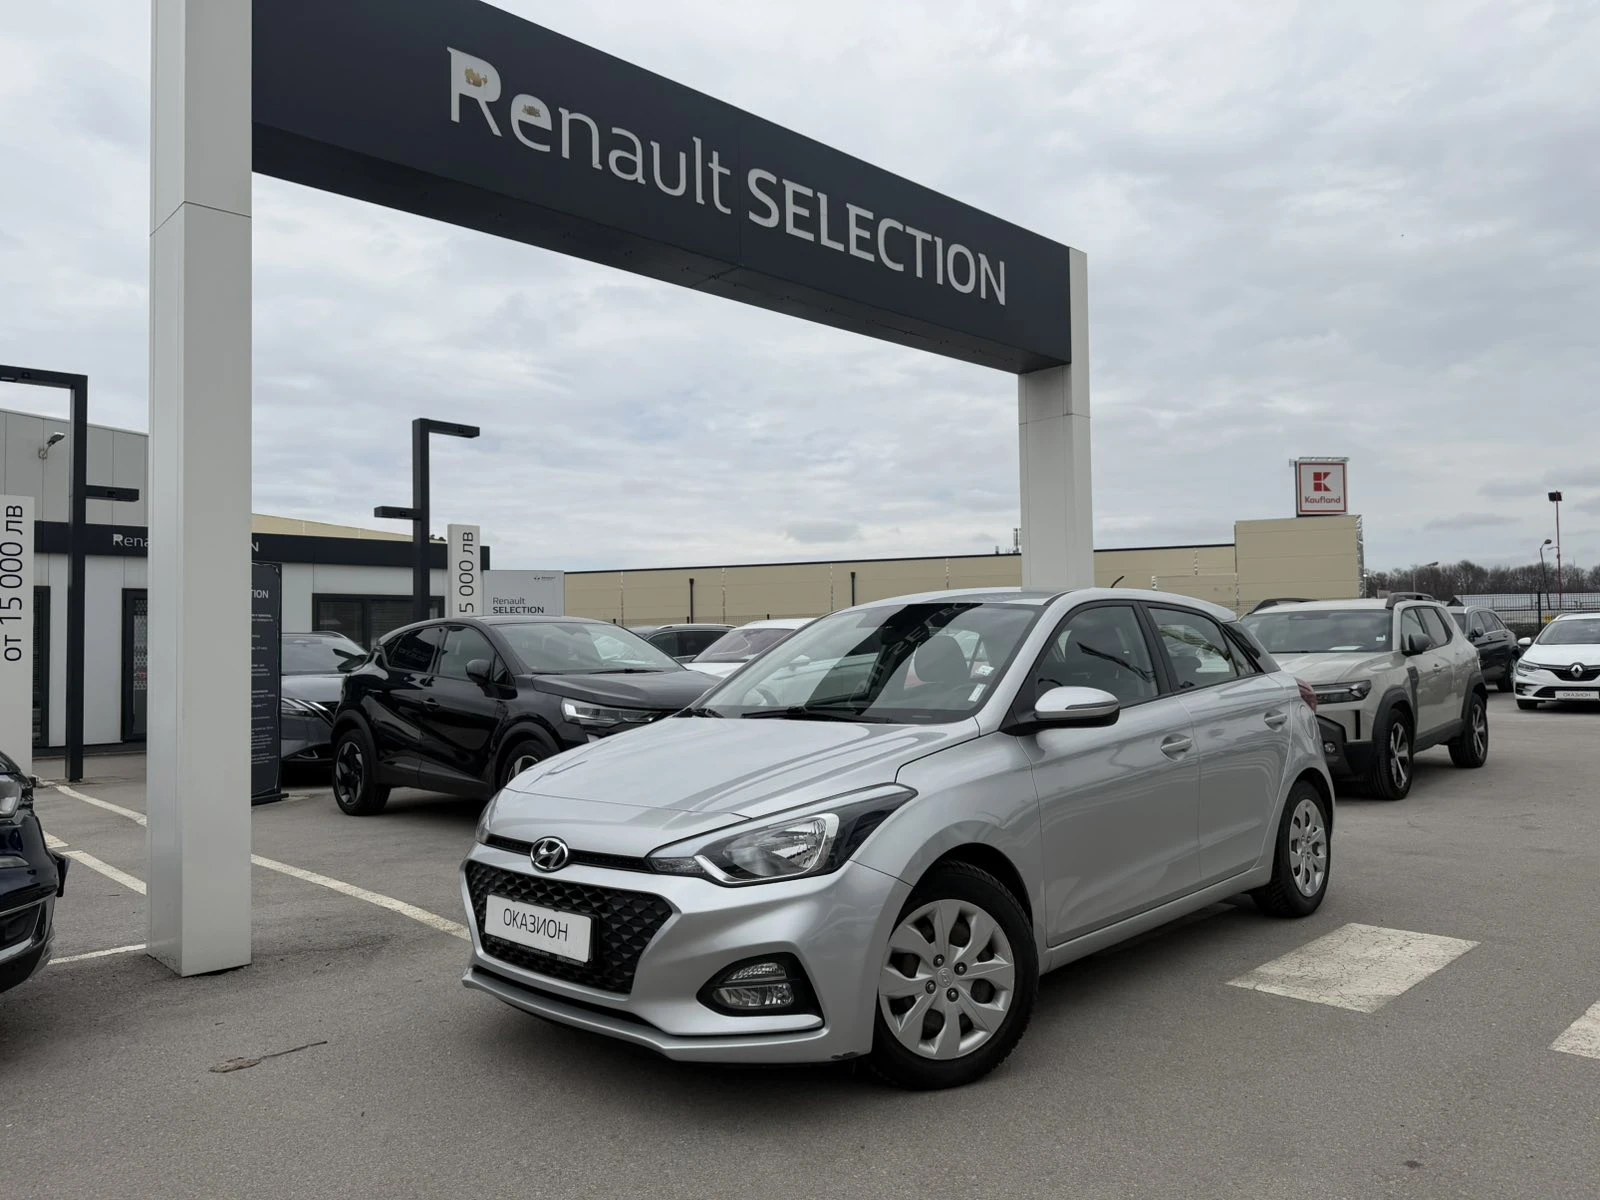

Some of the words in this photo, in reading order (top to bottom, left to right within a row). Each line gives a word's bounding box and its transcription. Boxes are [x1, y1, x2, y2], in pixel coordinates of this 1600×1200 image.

[447, 47, 732, 214] Renault
[747, 167, 1006, 306] SELECTION
[1304, 496, 1341, 504] Kaufland
[6, 505, 23, 535] ЛВ
[112, 533, 149, 547] Rena
[463, 532, 474, 555] ЛВ
[0, 541, 23, 589] 000
[459, 560, 474, 597] 000
[0, 597, 22, 625] 15
[493, 597, 525, 605] Renault
[493, 606, 544, 614] SELECTION
[4, 634, 22, 661] ОТ
[503, 908, 568, 942] ОКАЗИОН
